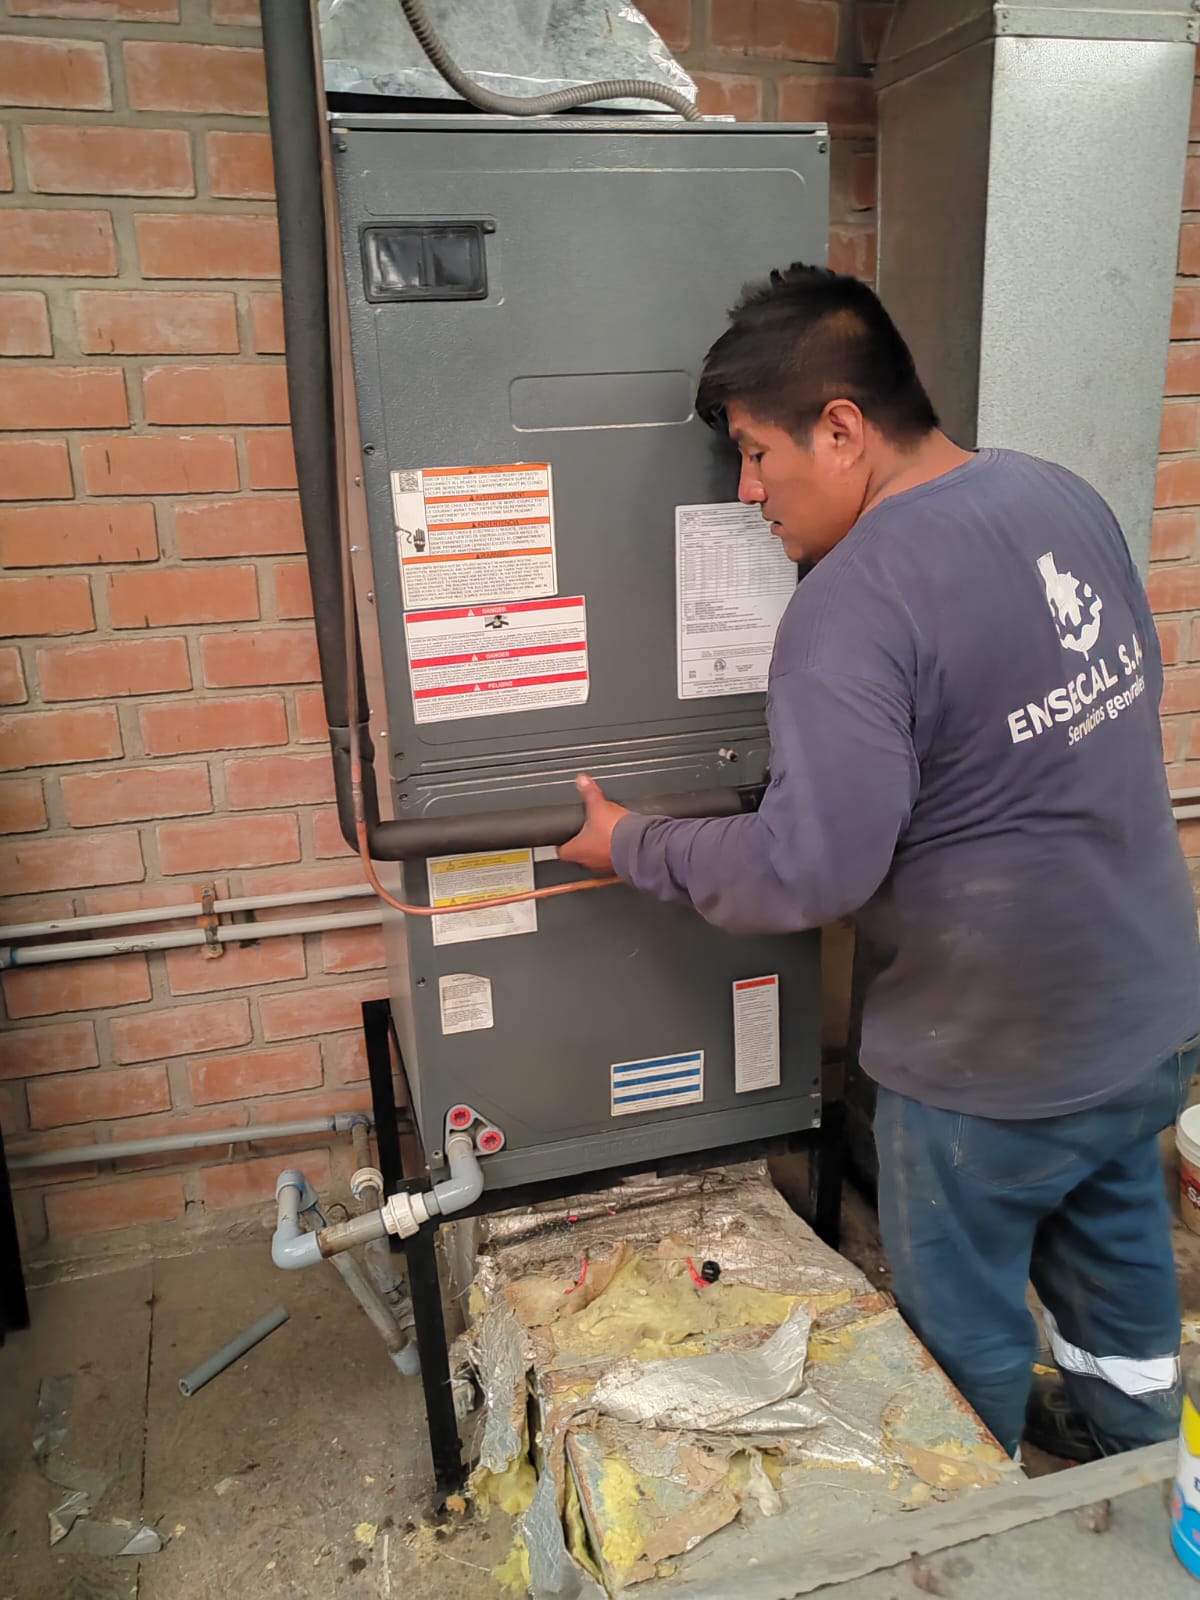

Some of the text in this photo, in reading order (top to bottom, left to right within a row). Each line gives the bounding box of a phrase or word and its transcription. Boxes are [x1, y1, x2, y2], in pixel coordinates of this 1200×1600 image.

[481, 606, 507, 614] DANGER
[485, 651, 510, 660] DANGER
[488, 680, 513, 689] PELIGRO
[1007, 659, 1119, 744] ENSECAL
[1068, 705, 1105, 746] Servicios
